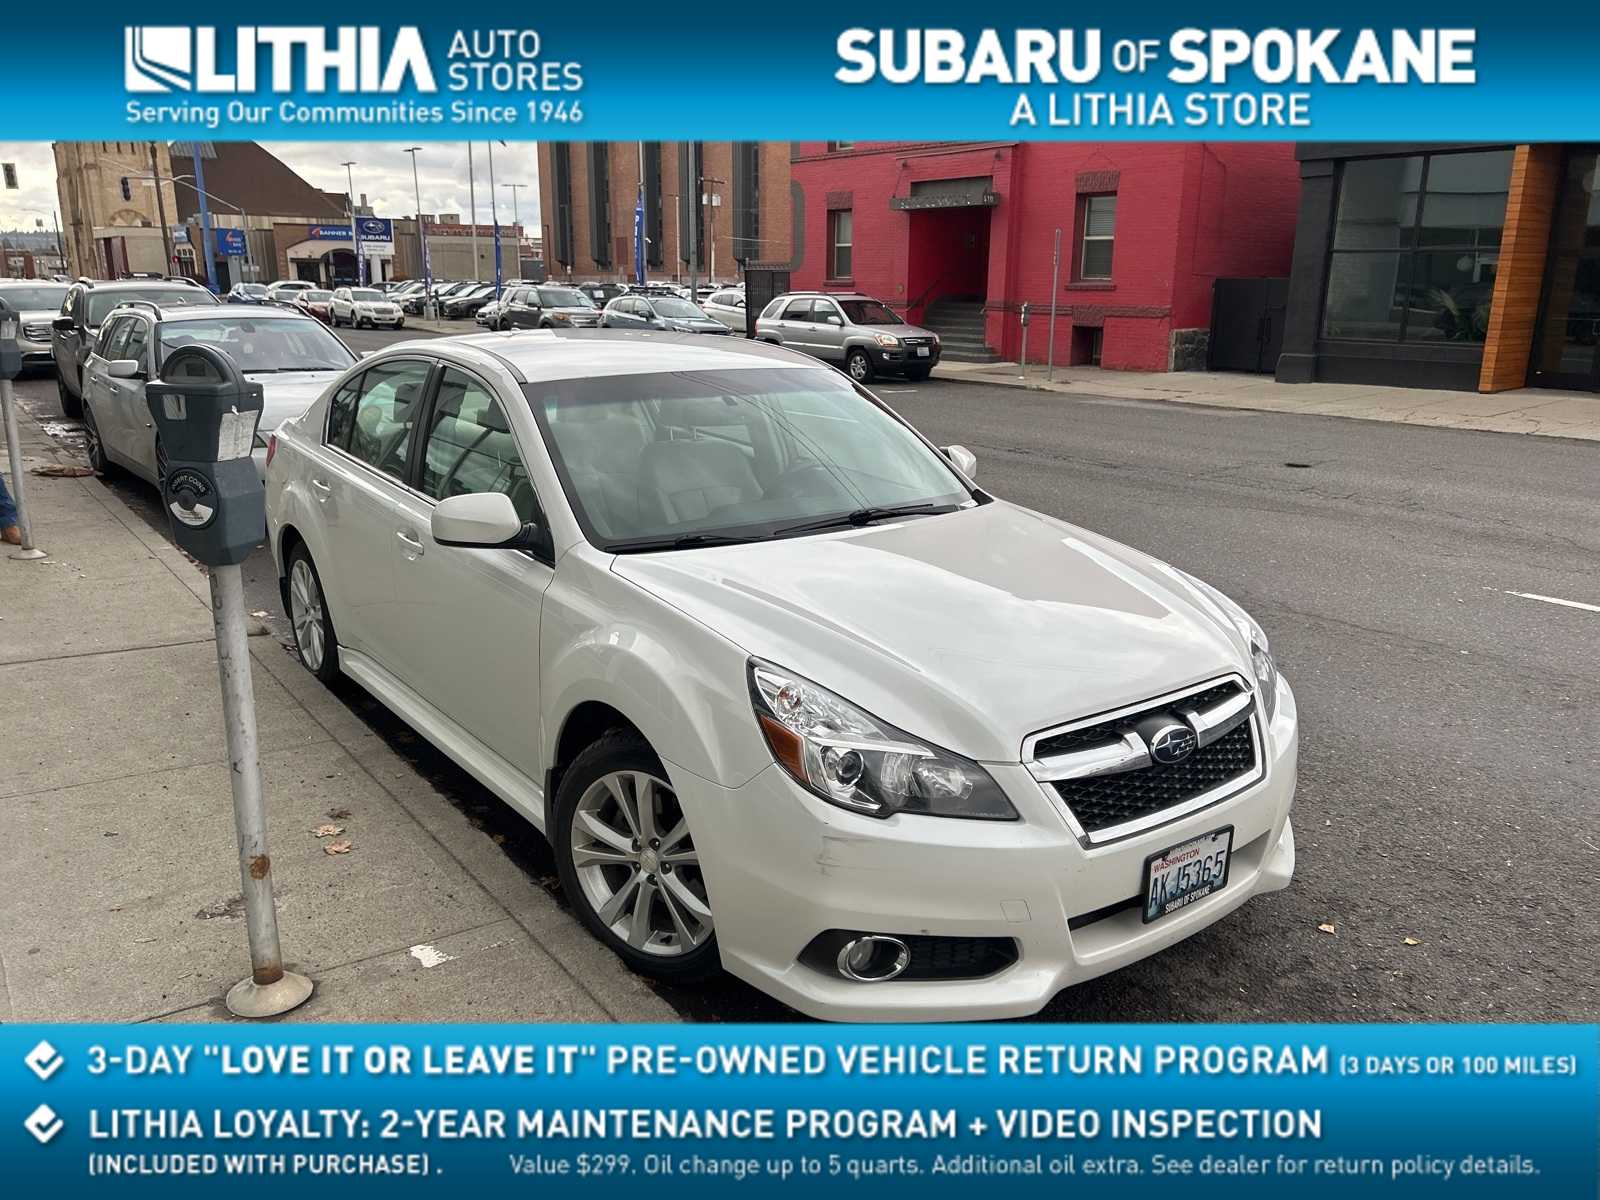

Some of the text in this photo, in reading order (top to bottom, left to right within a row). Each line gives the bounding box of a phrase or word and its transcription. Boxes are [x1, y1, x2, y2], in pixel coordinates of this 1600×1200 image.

[1153, 848, 1200, 873] WASHINGTON
[1149, 849, 1225, 910] AKJ5365
[1164, 885, 1210, 914] SUBARU OF SPOKANE
